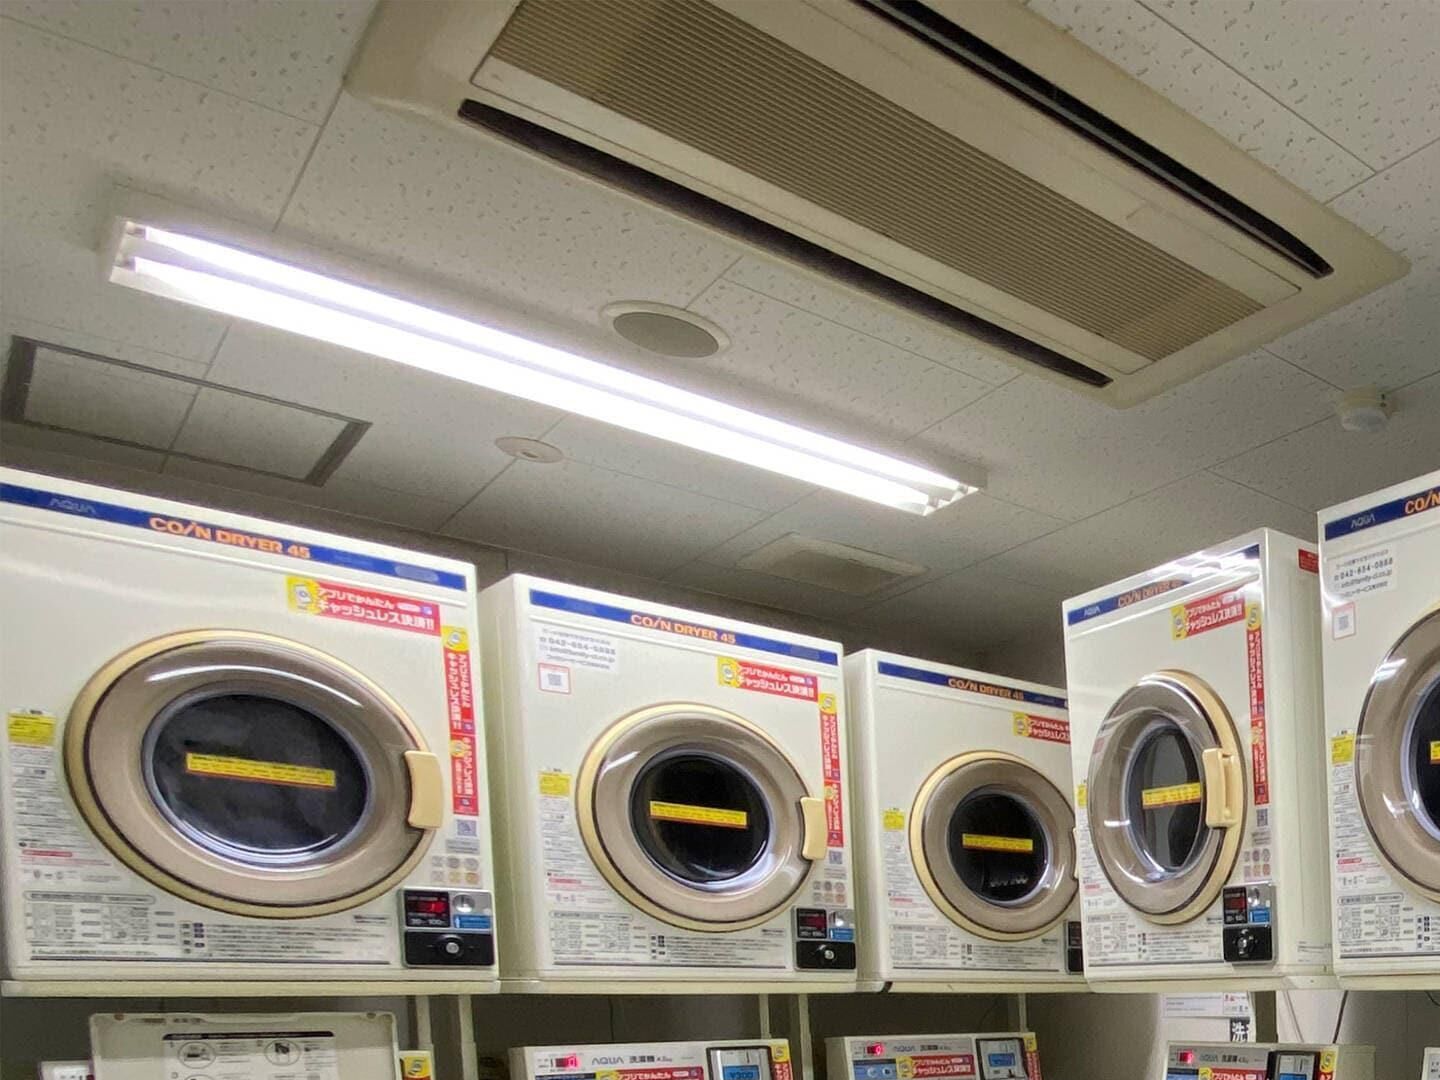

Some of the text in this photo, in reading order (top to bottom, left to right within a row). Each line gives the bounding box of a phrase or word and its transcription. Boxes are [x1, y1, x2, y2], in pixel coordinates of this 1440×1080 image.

[216, 530, 283, 554] DRYER
[287, 545, 311, 559] 45
[674, 622, 718, 641] DRYER
[720, 633, 736, 645] 45
[979, 685, 1012, 699] DRYER
[592, 1056, 625, 1065] AQUA
